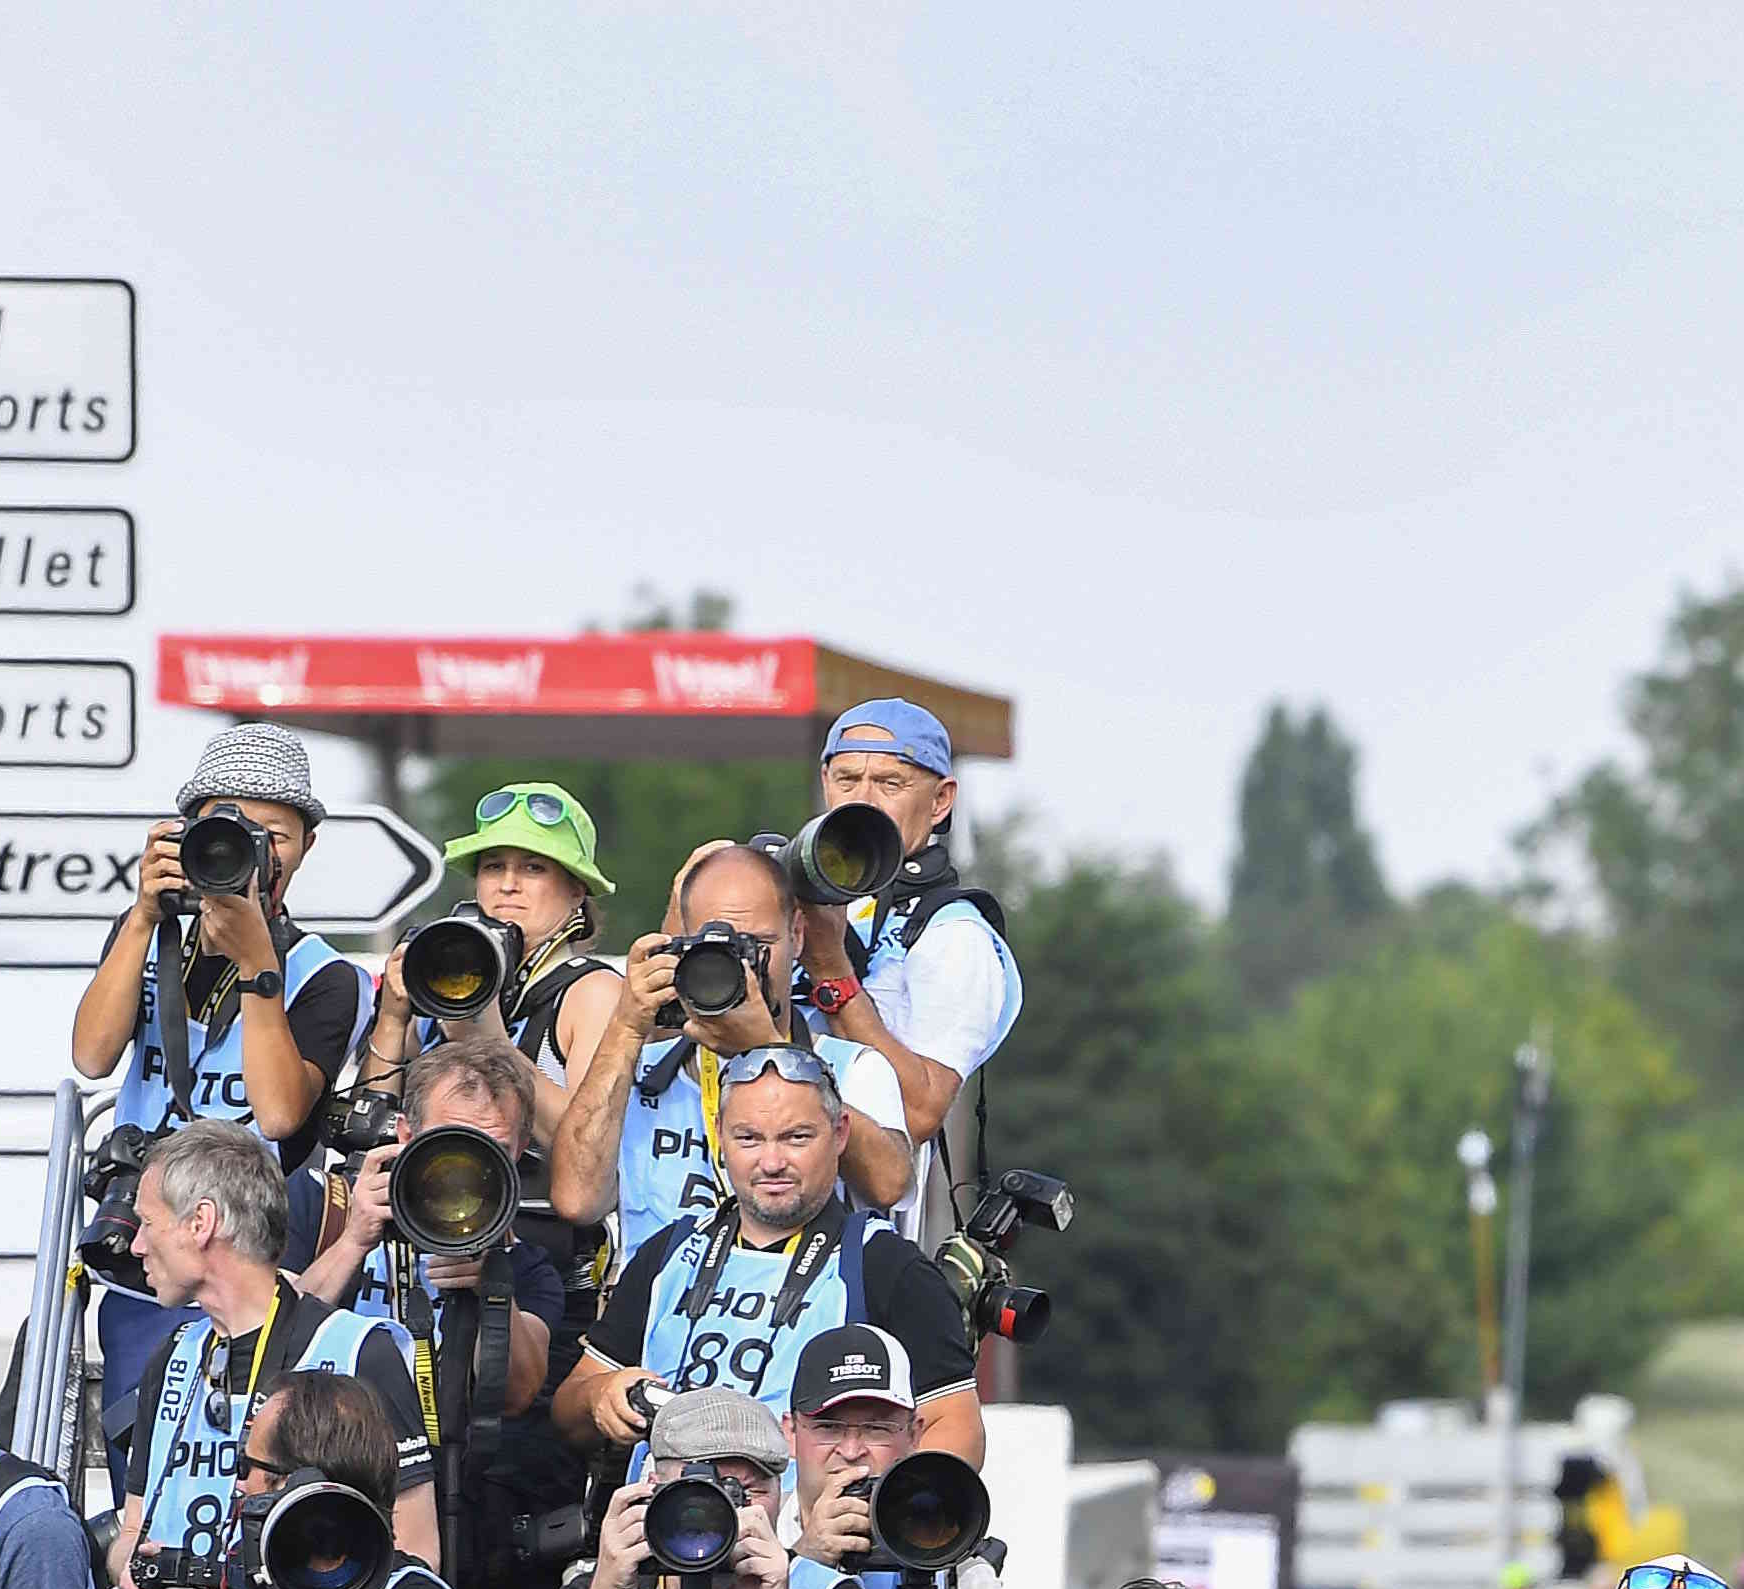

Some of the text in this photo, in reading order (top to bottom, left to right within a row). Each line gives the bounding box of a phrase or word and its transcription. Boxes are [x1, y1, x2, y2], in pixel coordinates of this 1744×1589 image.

[796, 1231, 826, 1276] Canon
[683, 1332, 773, 1398] 89
[828, 1364, 882, 1378] TISSOT
[161, 1358, 188, 1422] 2018
[418, 1374, 434, 1414] Nikon
